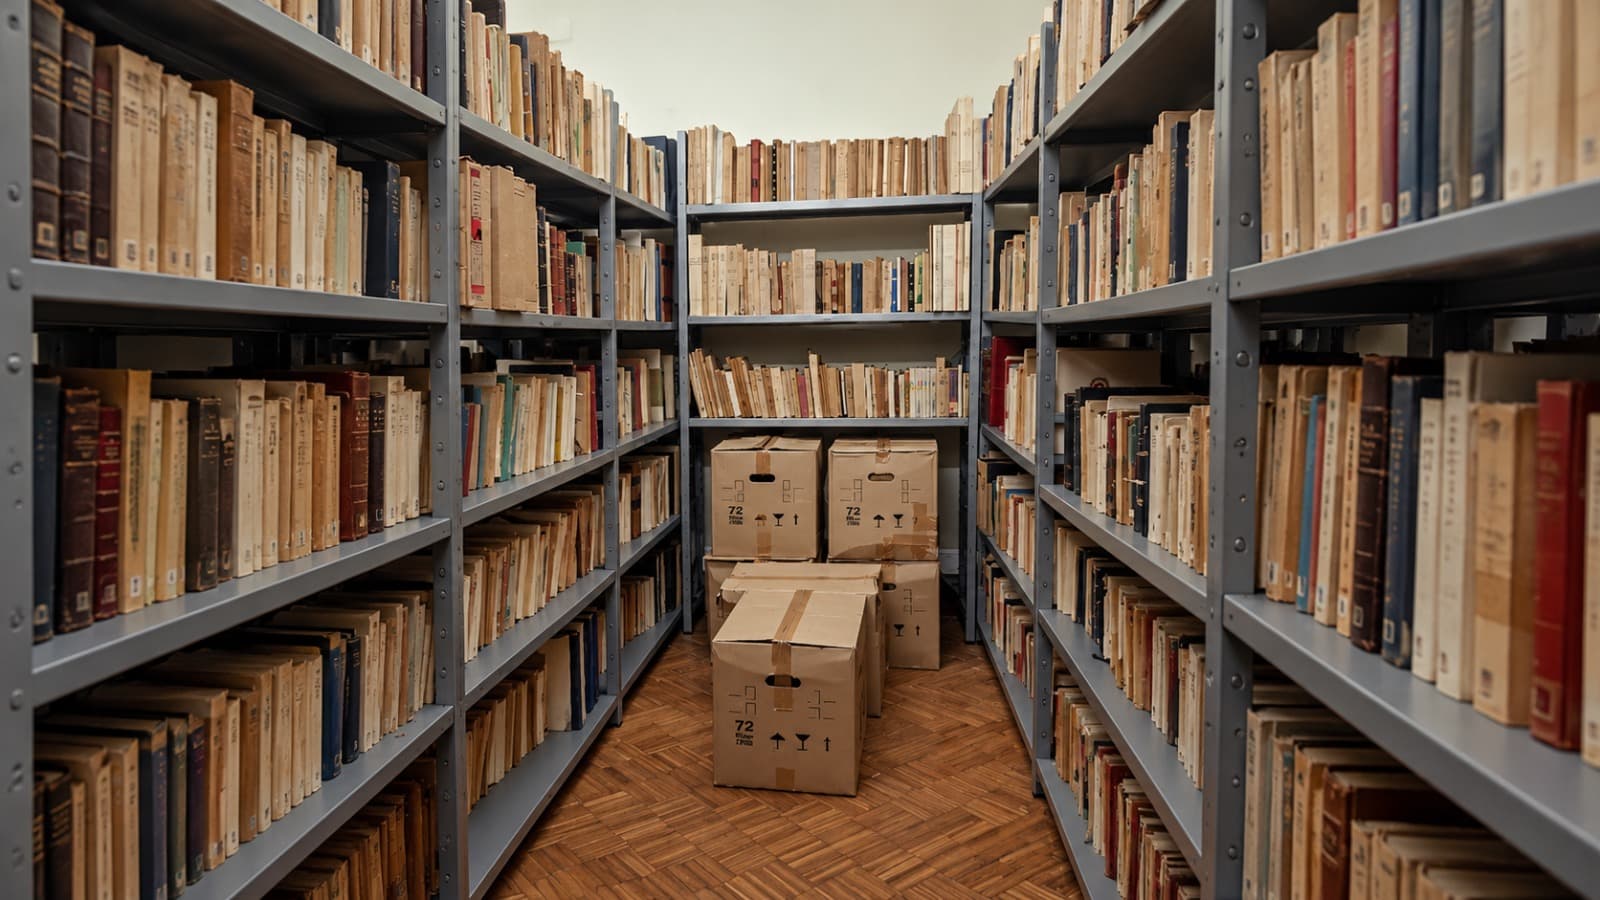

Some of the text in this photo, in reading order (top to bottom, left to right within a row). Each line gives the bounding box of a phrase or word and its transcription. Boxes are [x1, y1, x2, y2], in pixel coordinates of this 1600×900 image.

[728, 505, 743, 515] 72
[846, 506, 861, 516] 72
[735, 720, 754, 732] 72
